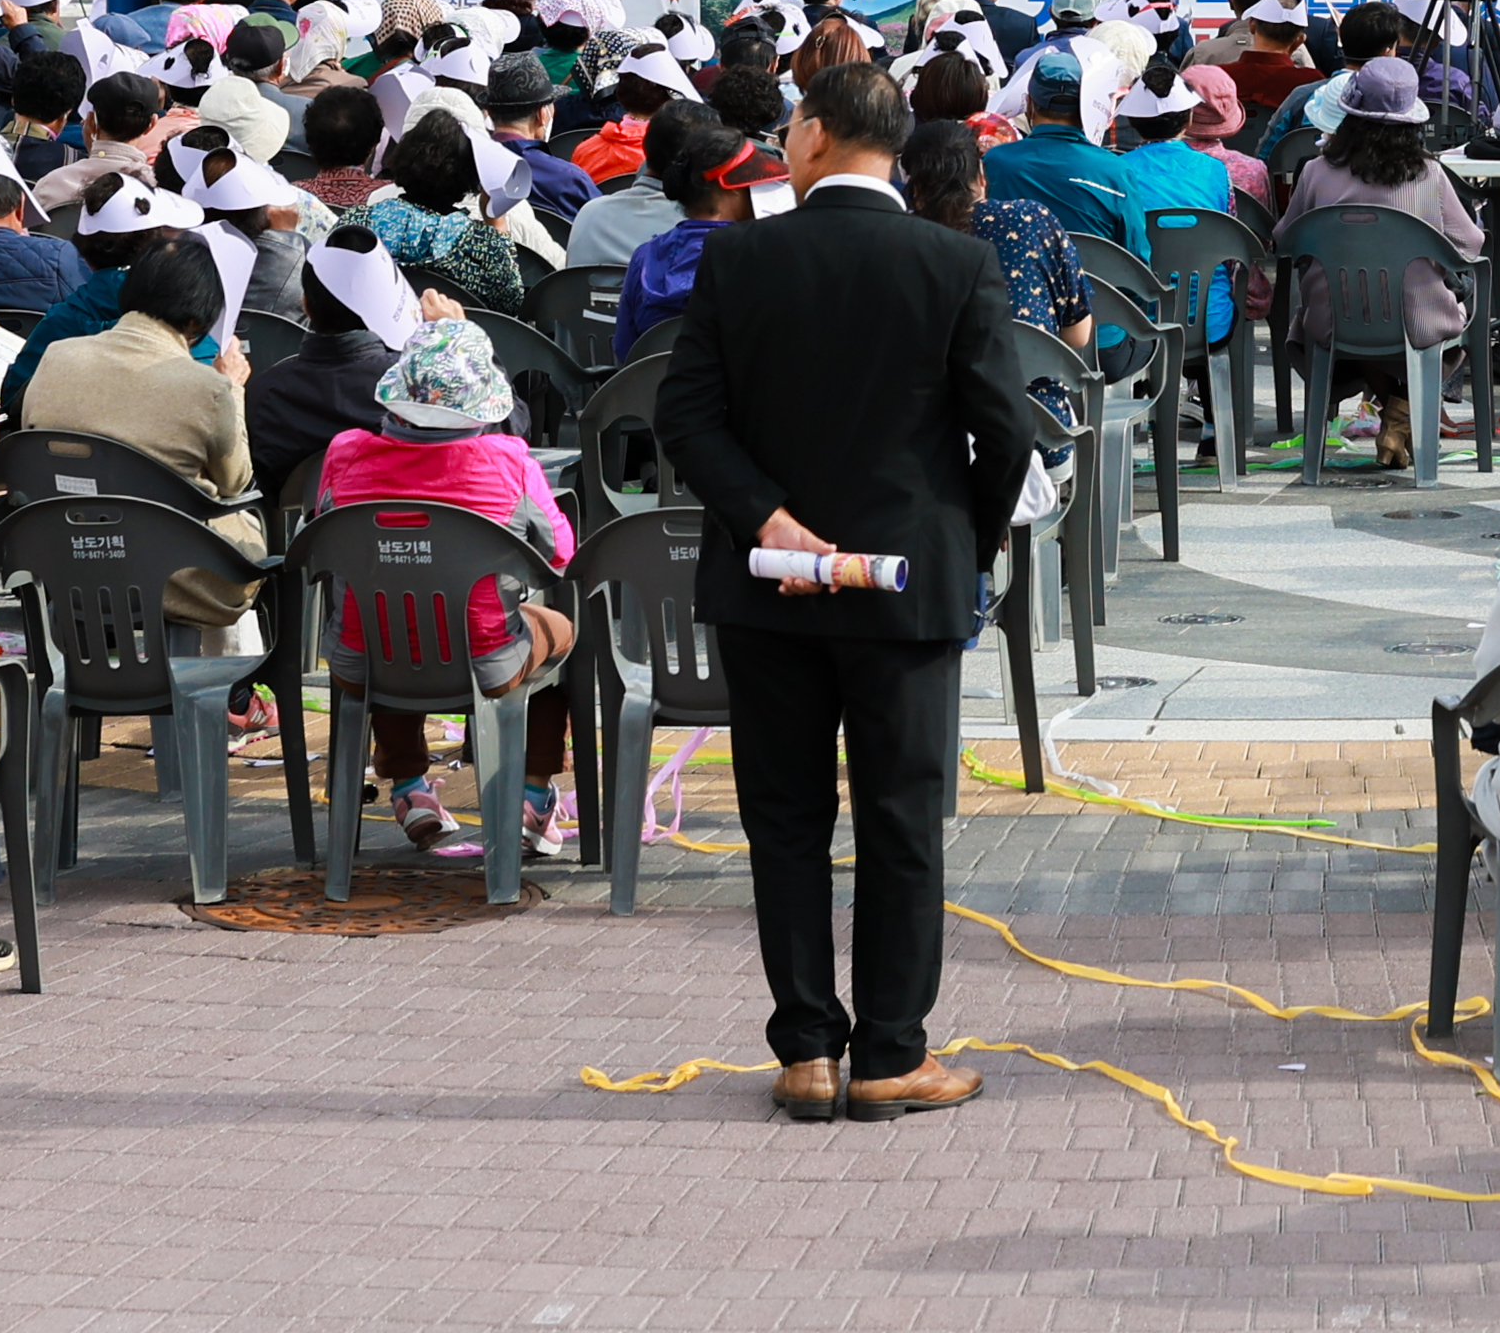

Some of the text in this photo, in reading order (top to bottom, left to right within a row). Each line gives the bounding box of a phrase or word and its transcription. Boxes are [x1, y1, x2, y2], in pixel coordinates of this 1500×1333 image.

[70, 535, 125, 549] 남도기획
[377, 540, 432, 554] 남도기획
[72, 549, 126, 559] 010-8471-3400
[379, 554, 432, 564] 010-8471-3400
